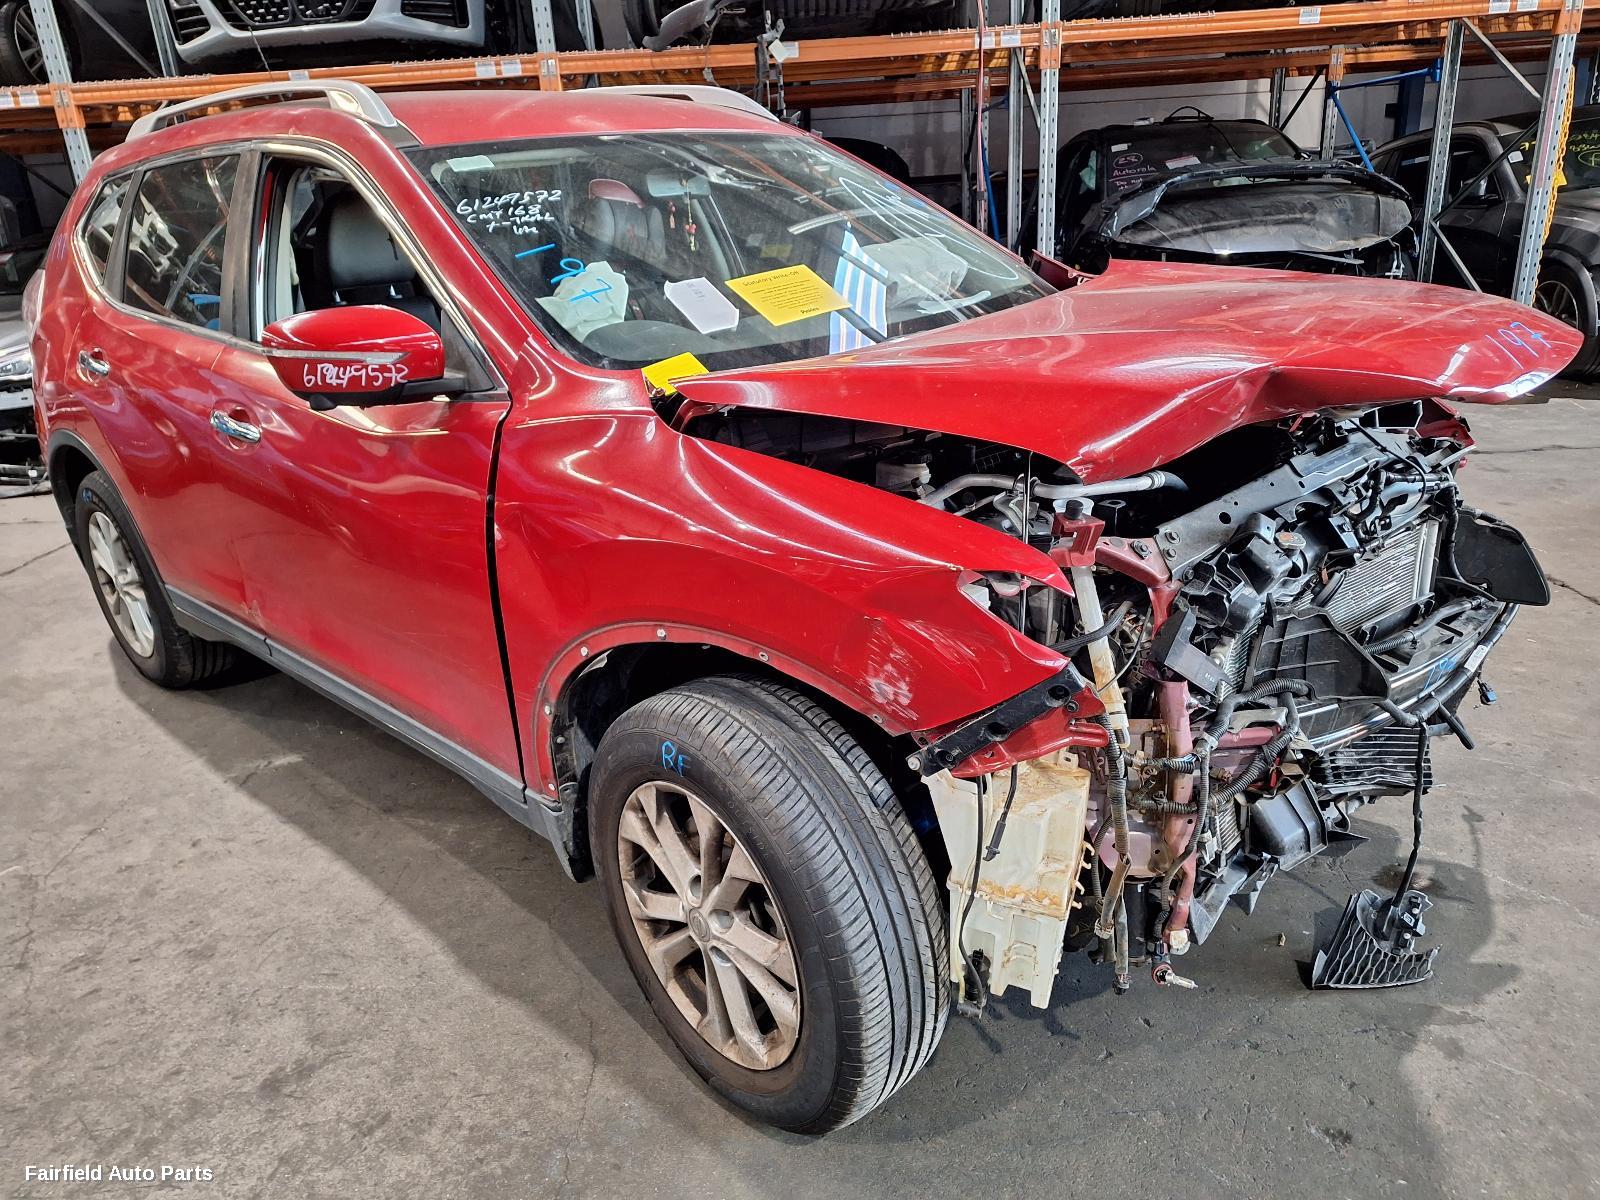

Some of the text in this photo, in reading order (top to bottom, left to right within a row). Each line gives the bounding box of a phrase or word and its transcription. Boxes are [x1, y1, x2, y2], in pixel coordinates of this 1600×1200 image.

[456, 190, 562, 215] 61249572
[508, 204, 541, 216] 168
[661, 740, 690, 778] RF
